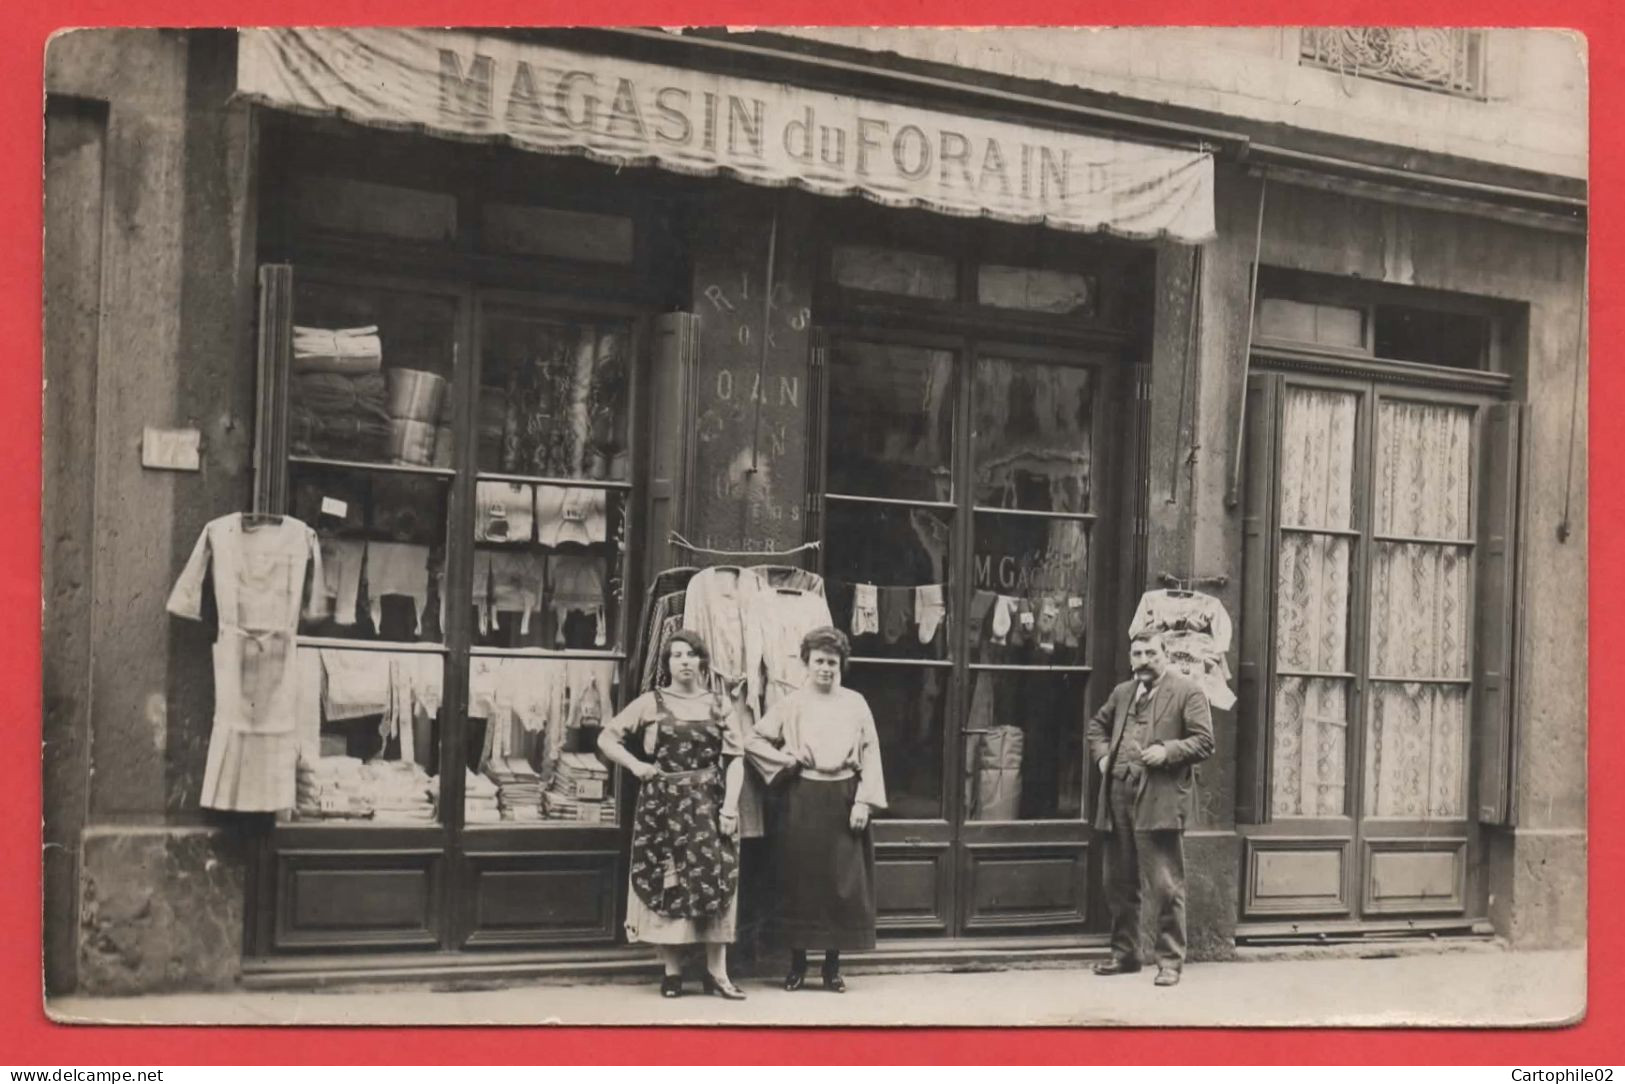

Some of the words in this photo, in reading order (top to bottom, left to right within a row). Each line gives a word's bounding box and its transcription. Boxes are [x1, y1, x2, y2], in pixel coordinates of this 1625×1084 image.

[436, 48, 765, 158] MAGASIN
[782, 105, 846, 170] du
[853, 116, 1073, 202] FORAIN
